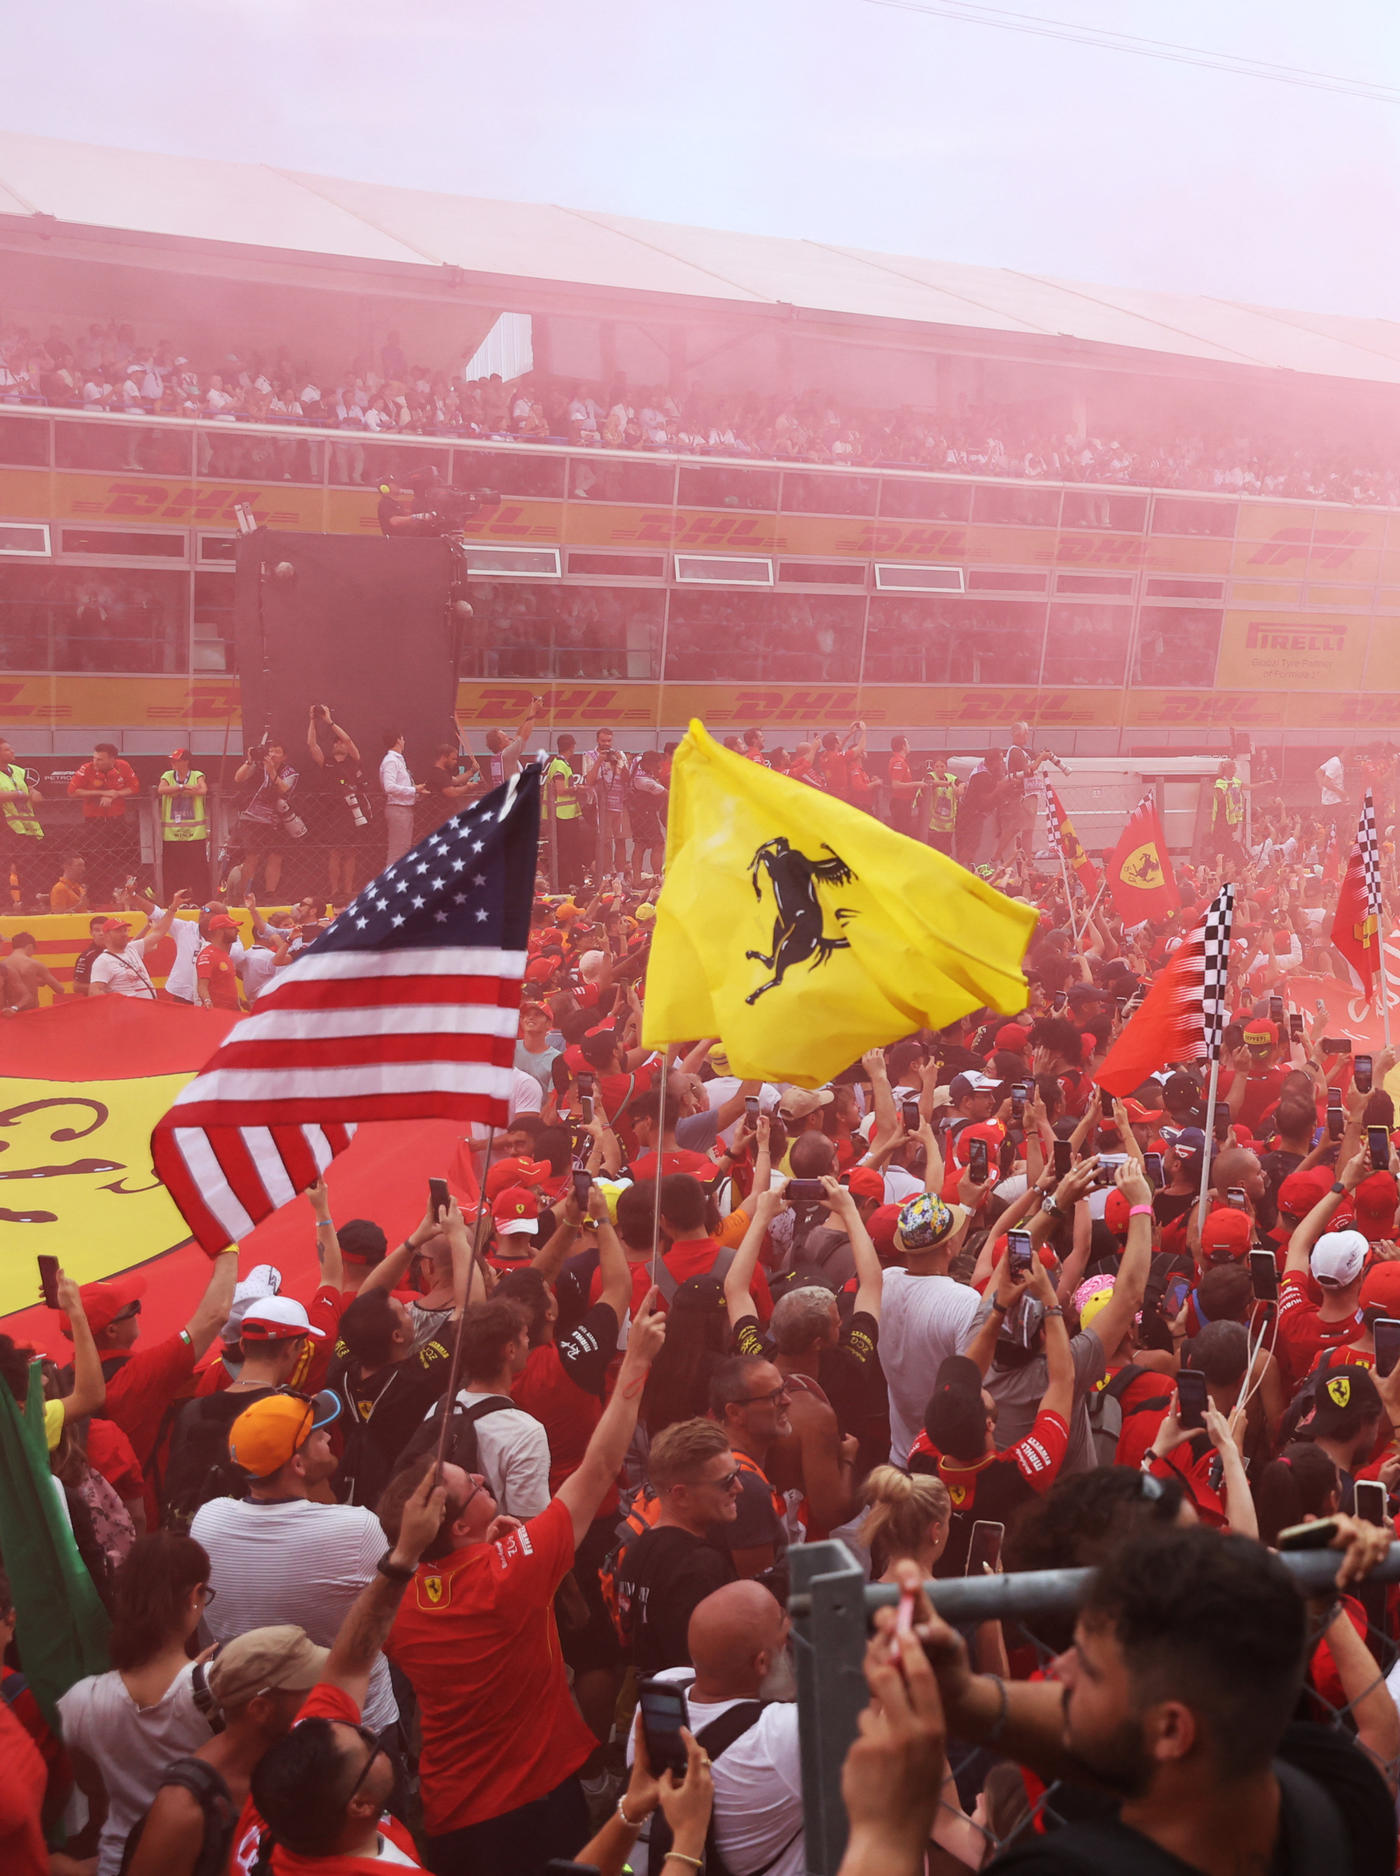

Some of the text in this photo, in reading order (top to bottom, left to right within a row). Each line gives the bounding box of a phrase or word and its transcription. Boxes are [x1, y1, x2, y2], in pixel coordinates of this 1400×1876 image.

[103, 483, 270, 519] DHL
[637, 514, 768, 547] DHL
[855, 524, 970, 557] DHL
[1053, 536, 1152, 566] DHL
[1246, 621, 1349, 651] PIRELLI
[1251, 657, 1280, 667] Global
[1281, 659, 1300, 669] Tyre
[1274, 670, 1308, 680] Formula
[475, 688, 629, 719] DHL
[731, 690, 863, 720] DHL
[957, 692, 1076, 722] DHL
[1158, 694, 1266, 722] DHL
